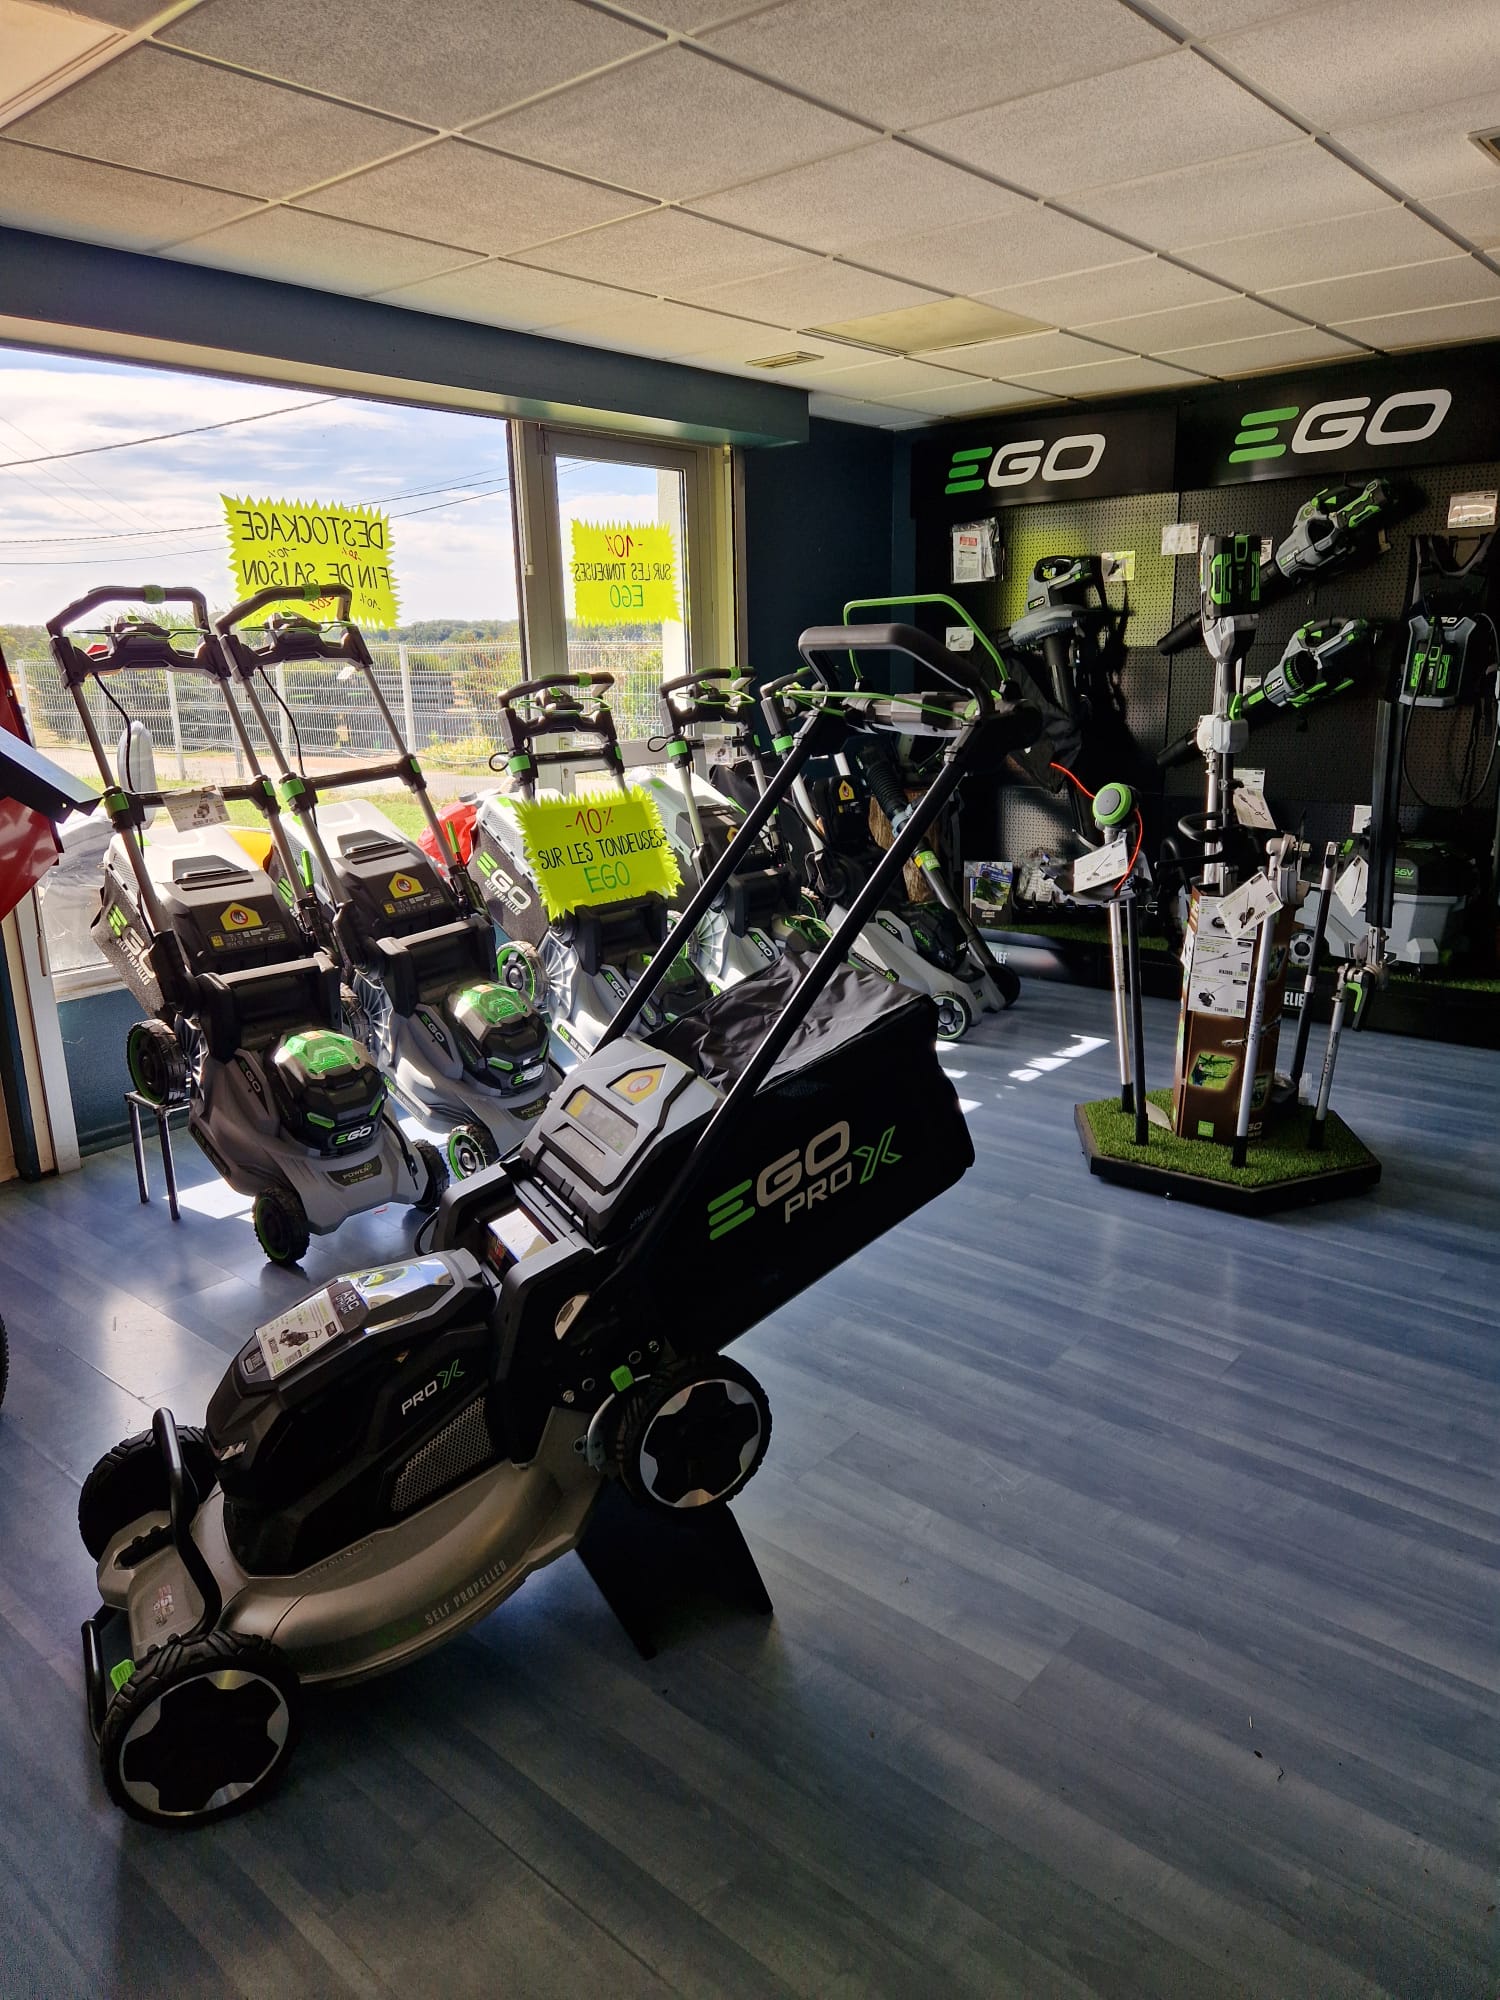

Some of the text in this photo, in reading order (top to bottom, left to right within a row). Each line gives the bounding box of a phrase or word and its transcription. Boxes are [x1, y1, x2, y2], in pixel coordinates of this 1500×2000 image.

[1228, 388, 1453, 464] EGO
[944, 433, 1106, 495] EGO
[565, 806, 614, 836] -10%
[537, 828, 663, 870] SUR LES TONDEUSES
[476, 851, 532, 910] EGO
[583, 860, 631, 894] EGO
[752, 931, 772, 957] EGO
[604, 971, 625, 999] EGO
[421, 1013, 444, 1042] EGO
[239, 1058, 261, 1092] EGO
[335, 1126, 372, 1144] EGO
[707, 1120, 850, 1240] EGO
[784, 1161, 853, 1224] PRO
[342, 1289, 360, 1310] ARC
[401, 1380, 438, 1415] PRO
[424, 1559, 507, 1625] SELF PROPELLED
